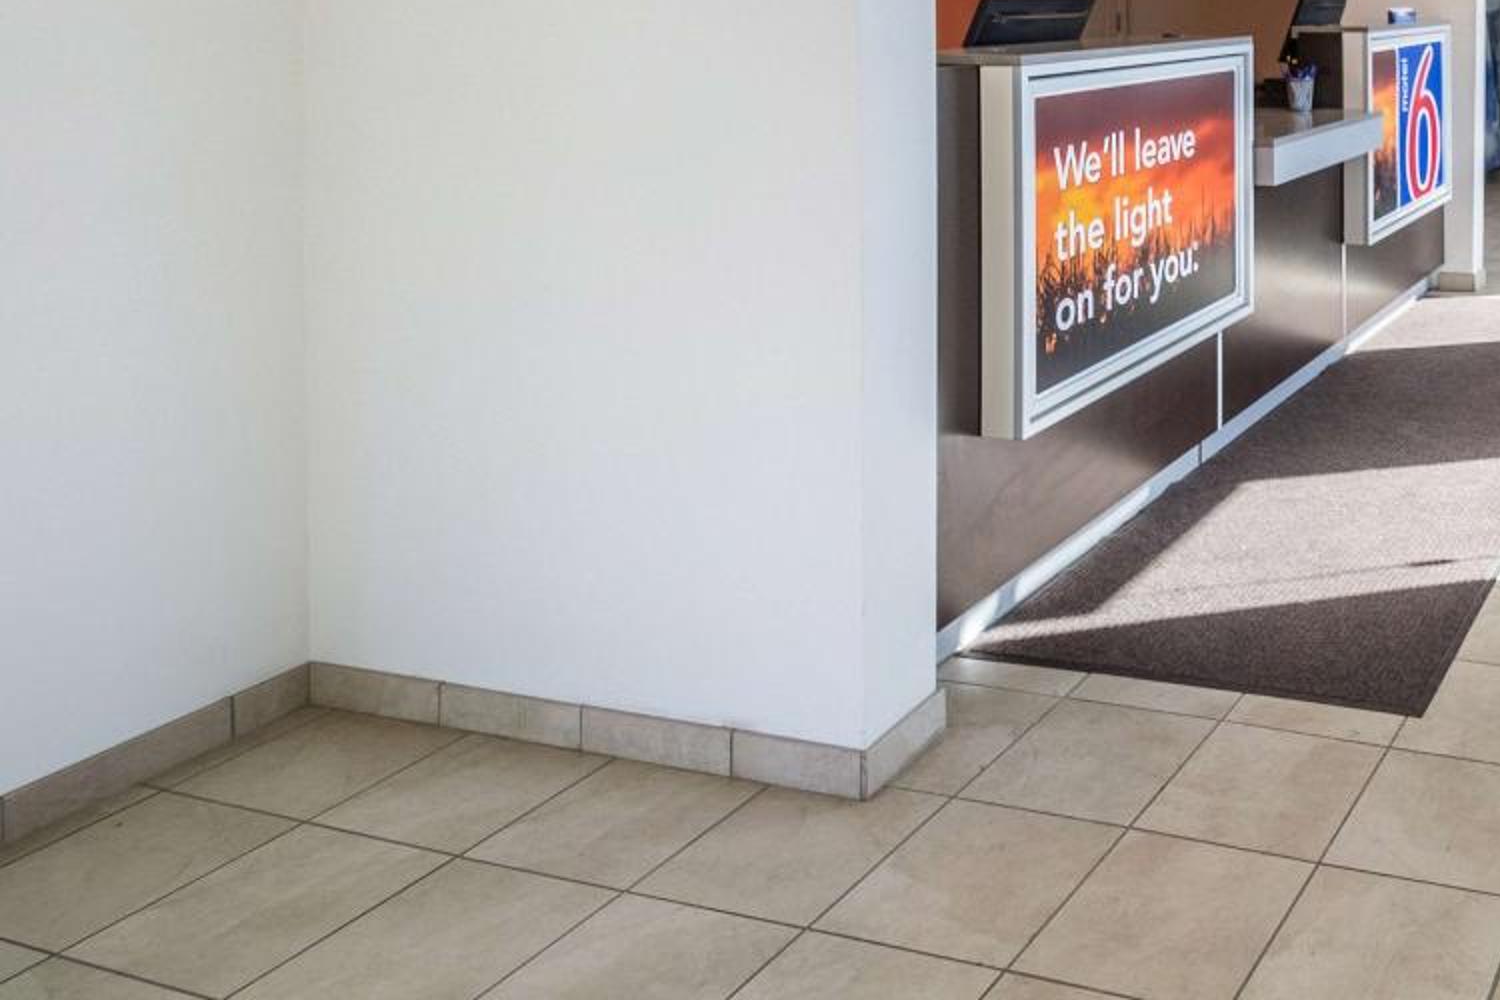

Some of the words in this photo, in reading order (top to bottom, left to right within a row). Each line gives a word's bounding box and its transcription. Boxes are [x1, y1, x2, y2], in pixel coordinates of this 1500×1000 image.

[1053, 130, 1125, 190] We'll
[1135, 126, 1196, 171] leave
[1406, 45, 1441, 200] 6
[1055, 210, 1105, 261] the
[1113, 186, 1174, 247] light
[1055, 288, 1095, 331] on
[1103, 263, 1144, 311] for
